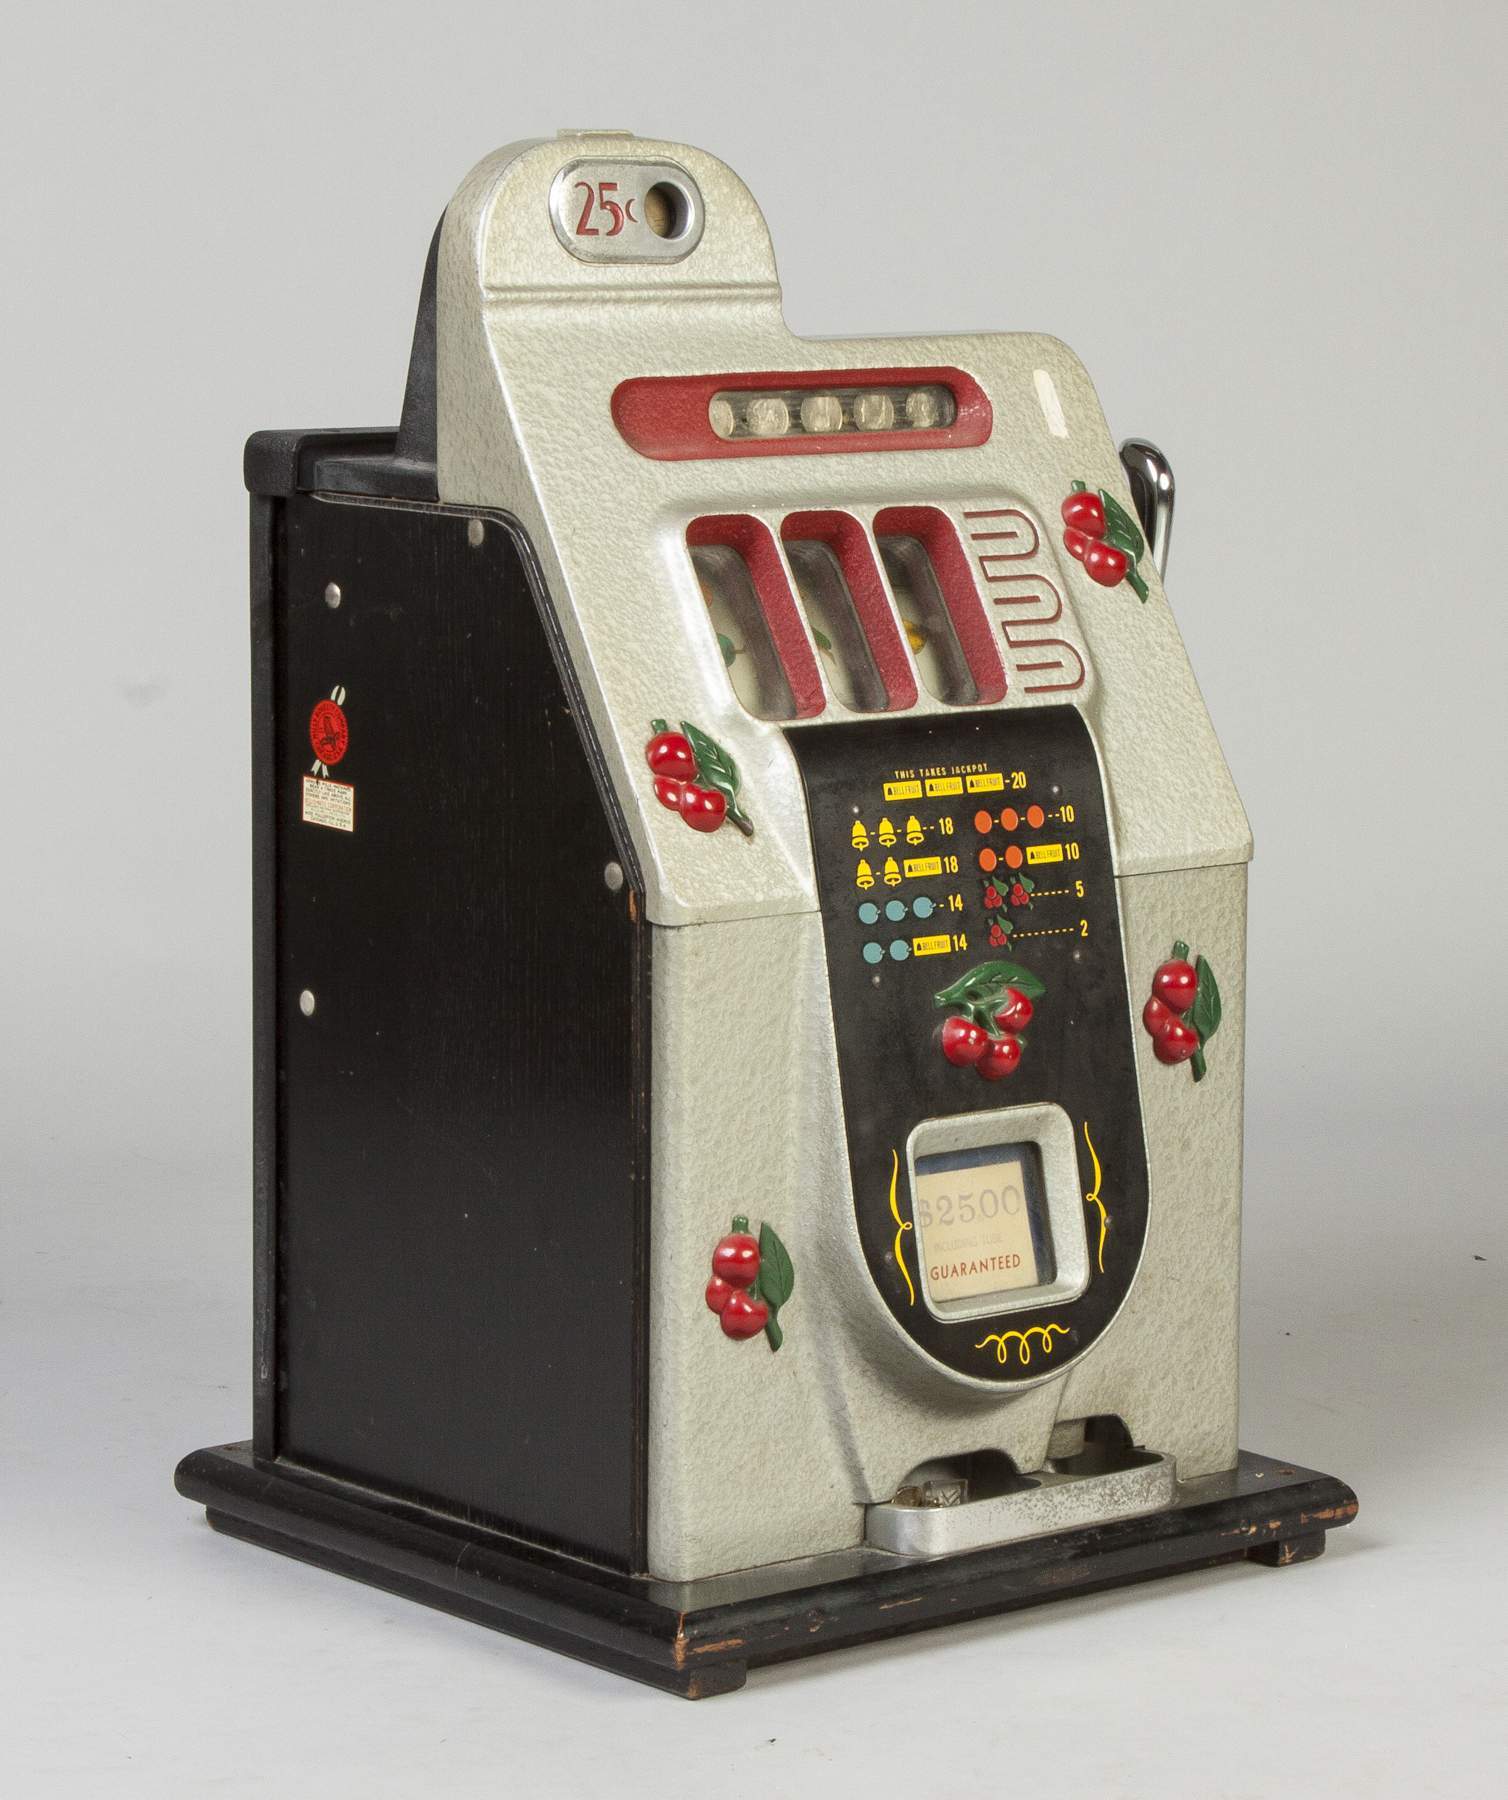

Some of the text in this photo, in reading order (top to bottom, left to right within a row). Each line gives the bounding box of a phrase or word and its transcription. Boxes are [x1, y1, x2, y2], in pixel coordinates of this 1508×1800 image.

[894, 763, 988, 779] THIS TAKES JACKPOT
[1059, 805, 1075, 823] 10
[939, 817, 954, 835] 18
[1065, 842, 1080, 860] 10
[943, 856, 959, 874] 18
[1075, 880, 1085, 898] 5
[948, 894, 964, 912] 14
[1079, 920, 1089, 937] 2
[952, 934, 968, 952] 14
[930, 1254, 1021, 1281] GUARANTEED
